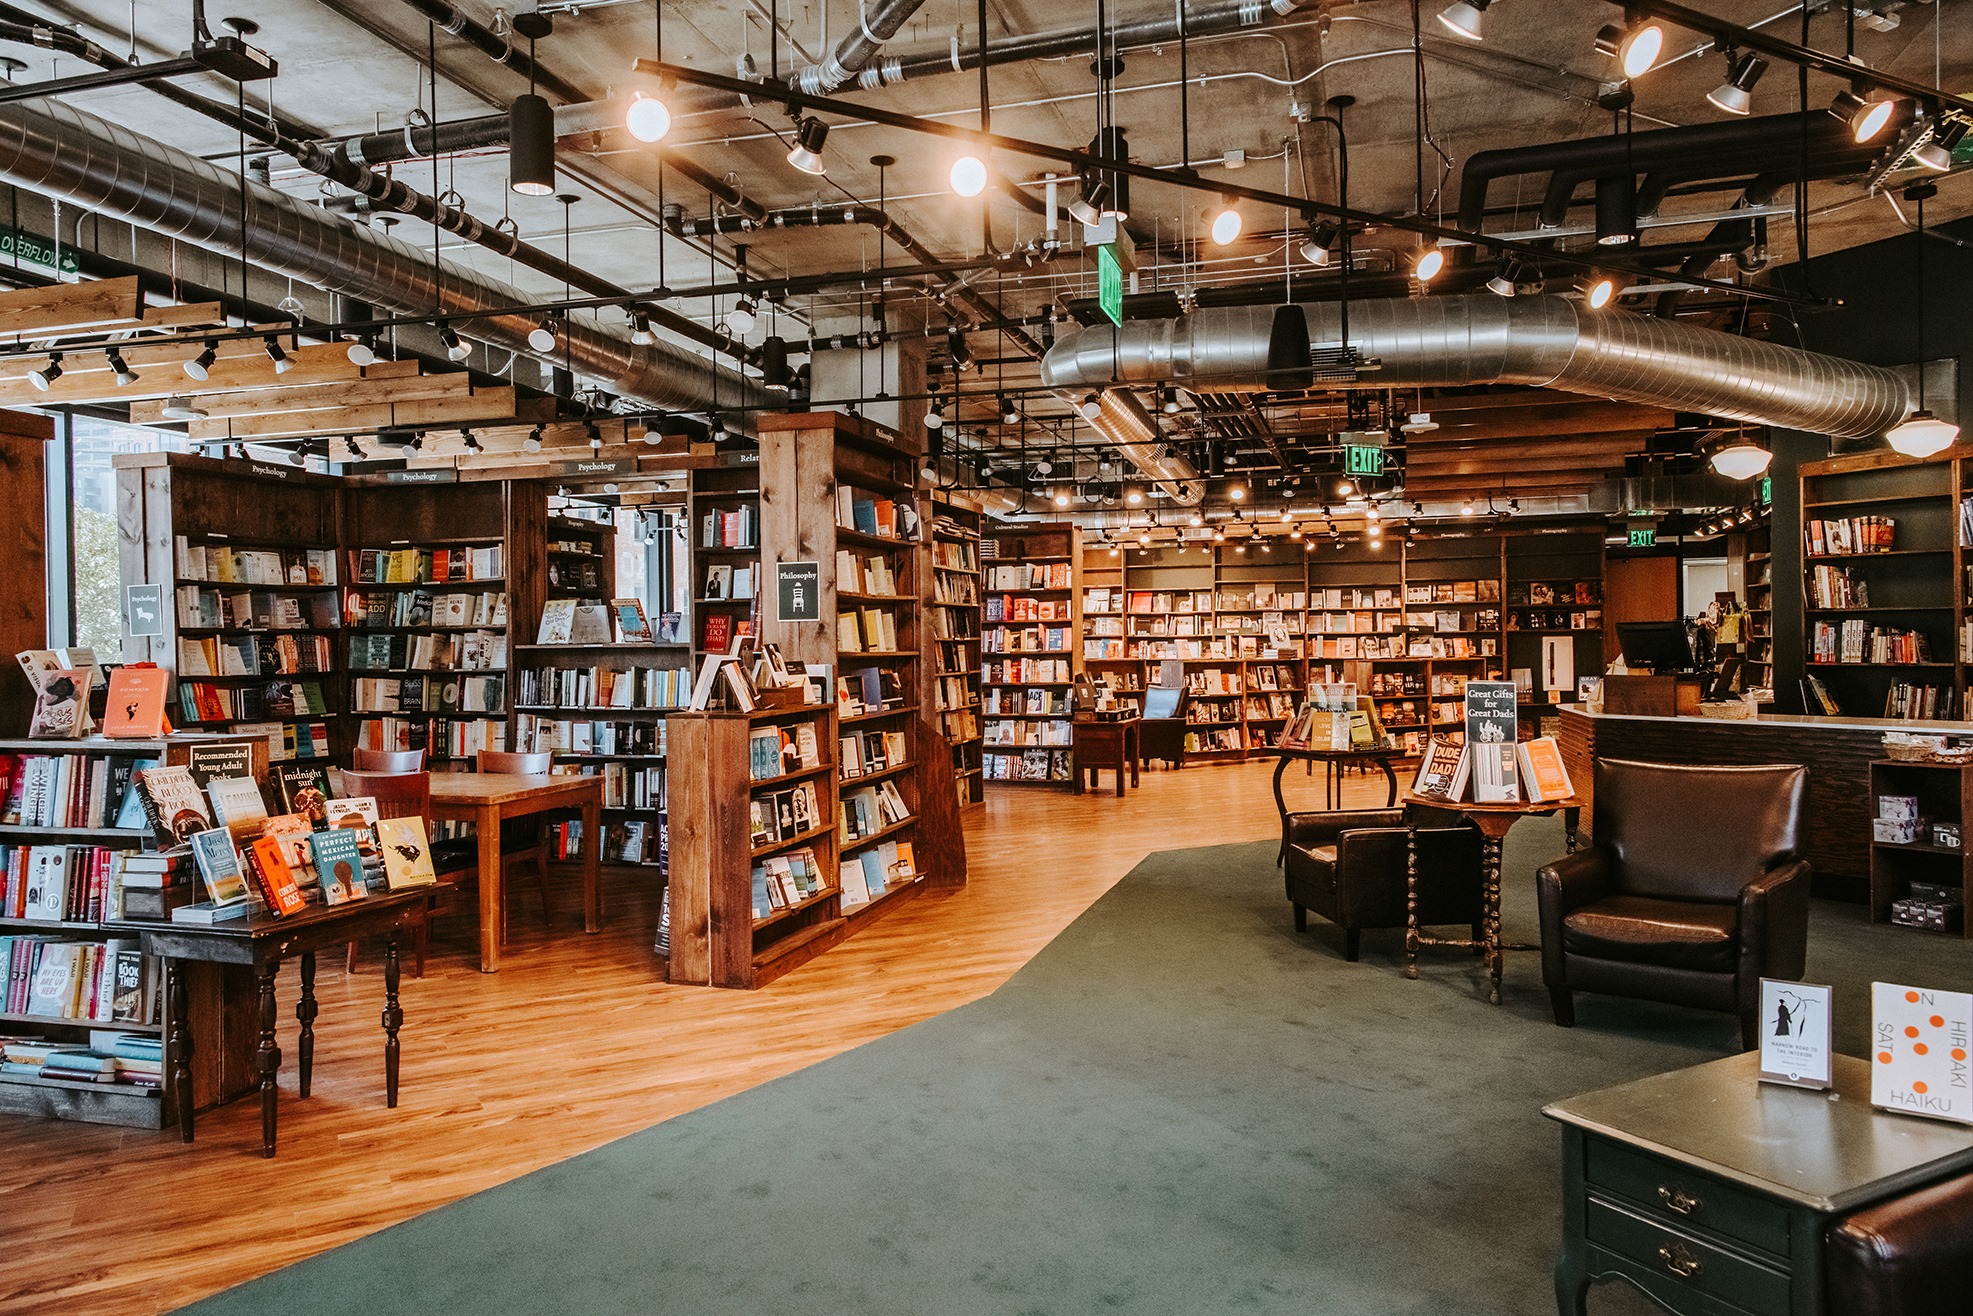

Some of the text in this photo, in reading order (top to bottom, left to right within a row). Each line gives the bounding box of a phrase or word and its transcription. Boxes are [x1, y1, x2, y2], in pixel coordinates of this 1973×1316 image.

[1351, 447, 1380, 472] EXIT
[252, 465, 288, 479] Psychology
[578, 462, 616, 473] Psychology
[402, 473, 437, 482] Psychology
[1630, 530, 1653, 545] EXIT
[780, 571, 817, 580] Philosophy
[368, 604, 385, 613] ADD
[1029, 691, 1042, 700] ACE
[1468, 690, 1513, 699] Great Gifts
[1484, 699, 1497, 708] for
[1468, 709, 1514, 718] Great Dads
[194, 750, 248, 761] Recommended
[1434, 746, 1461, 760] DUDE
[199, 761, 243, 773] Young Adult
[1430, 762, 1457, 776] DAD!
[115, 768, 129, 780] WE
[284, 767, 322, 782] midnight
[150, 774, 193, 786] CHILDREN
[297, 779, 314, 787] sun
[160, 785, 193, 798] BLOOD
[169, 801, 194, 811] BONE
[660, 824, 668, 833] AC
[208, 836, 224, 847] Just
[320, 837, 353, 848] PERFECT
[206, 848, 231, 858] Mercy
[321, 845, 355, 855] MEXICAN
[323, 852, 356, 862] DAUGHTER
[283, 892, 301, 907] ROSE
[42, 968, 67, 976] MY EYES
[119, 964, 139, 977] BOOK
[40, 977, 65, 986] ARE UP
[119, 976, 138, 988] THIEF
[41, 987, 58, 995] HERE
[1890, 1089, 1951, 1112] HAIKU
